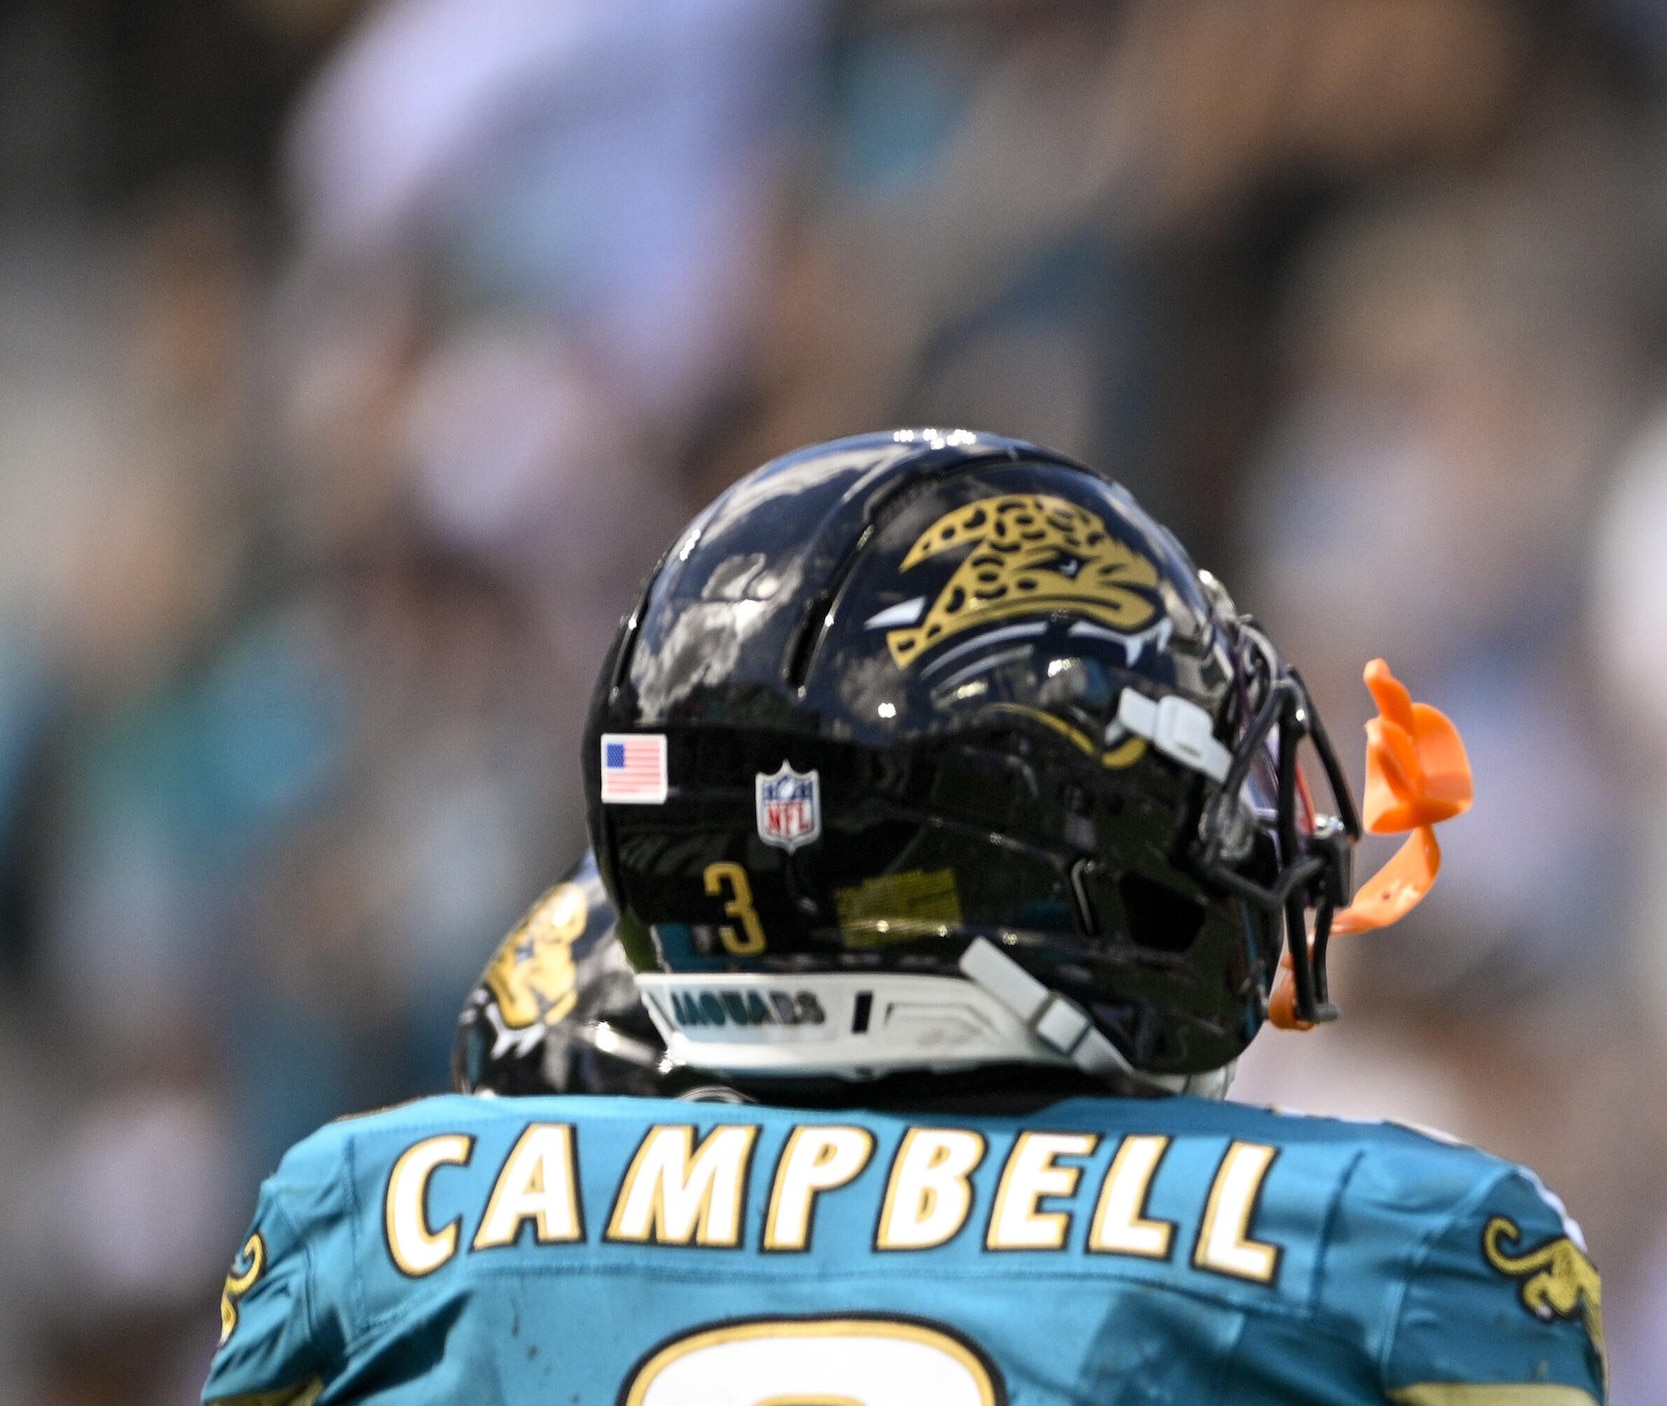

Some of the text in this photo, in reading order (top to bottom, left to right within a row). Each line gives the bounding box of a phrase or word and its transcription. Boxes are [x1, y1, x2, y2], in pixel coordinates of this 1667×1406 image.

[766, 800, 812, 836] NFL
[703, 861, 767, 957] 3
[384, 1122, 1281, 1284] CAMPBELL
